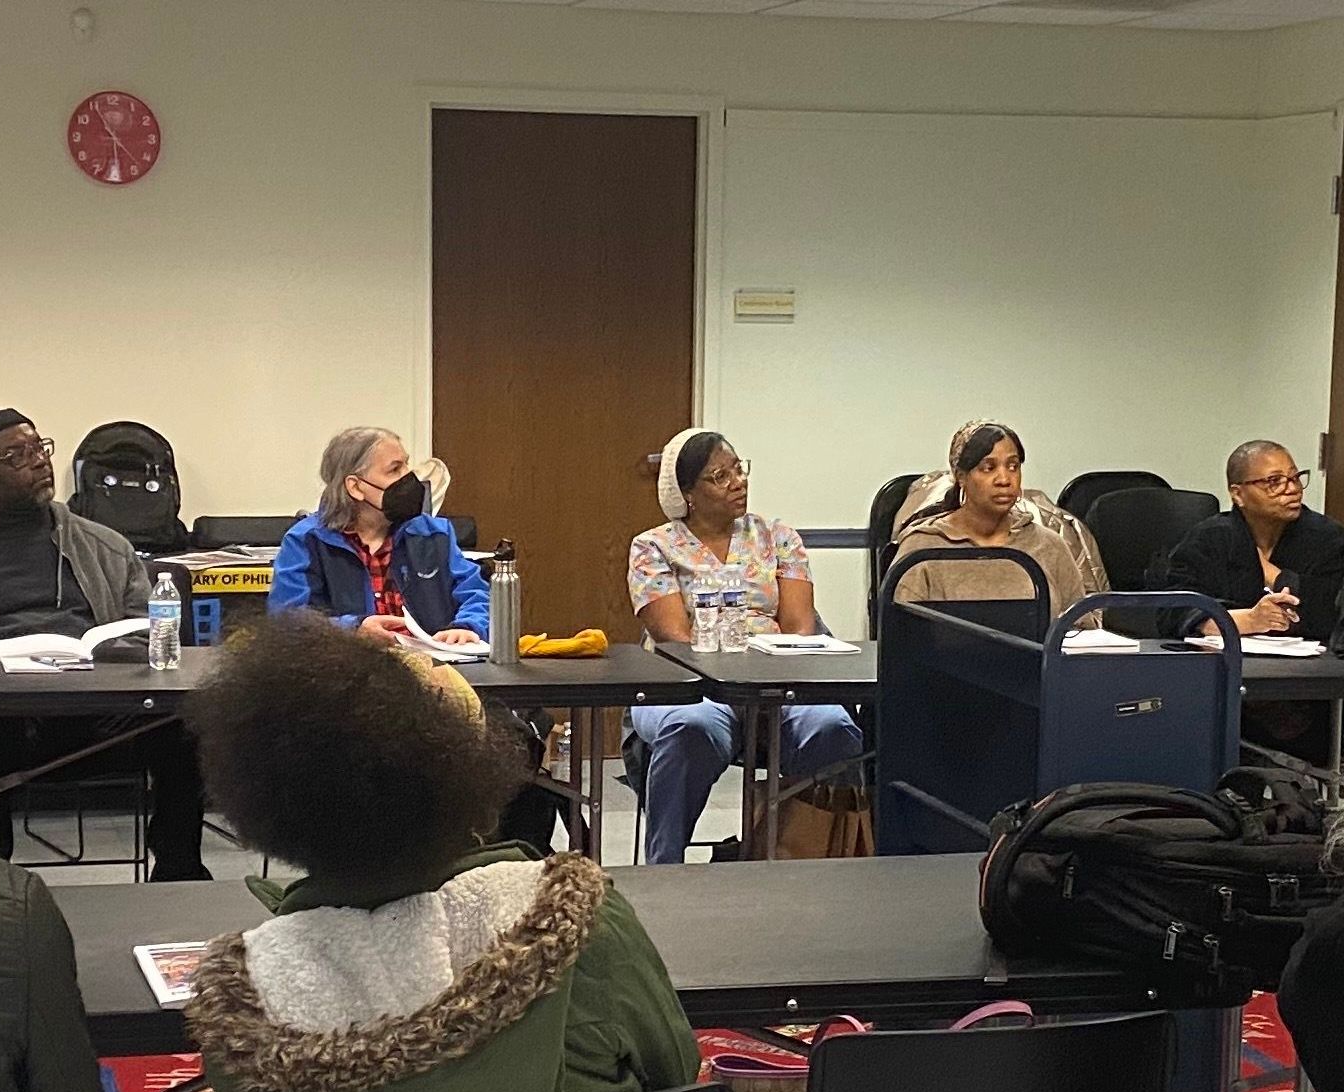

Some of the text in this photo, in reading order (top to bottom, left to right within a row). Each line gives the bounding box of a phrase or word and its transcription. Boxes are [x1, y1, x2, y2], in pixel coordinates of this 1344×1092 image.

[106, 95, 119, 106] 12
[77, 114, 89, 125] 10
[141, 115, 151, 126] 2
[72, 131, 81, 143] 9
[147, 133, 156, 145] 3
[221, 573, 239, 585] OF
[242, 573, 272, 585] PHIL
